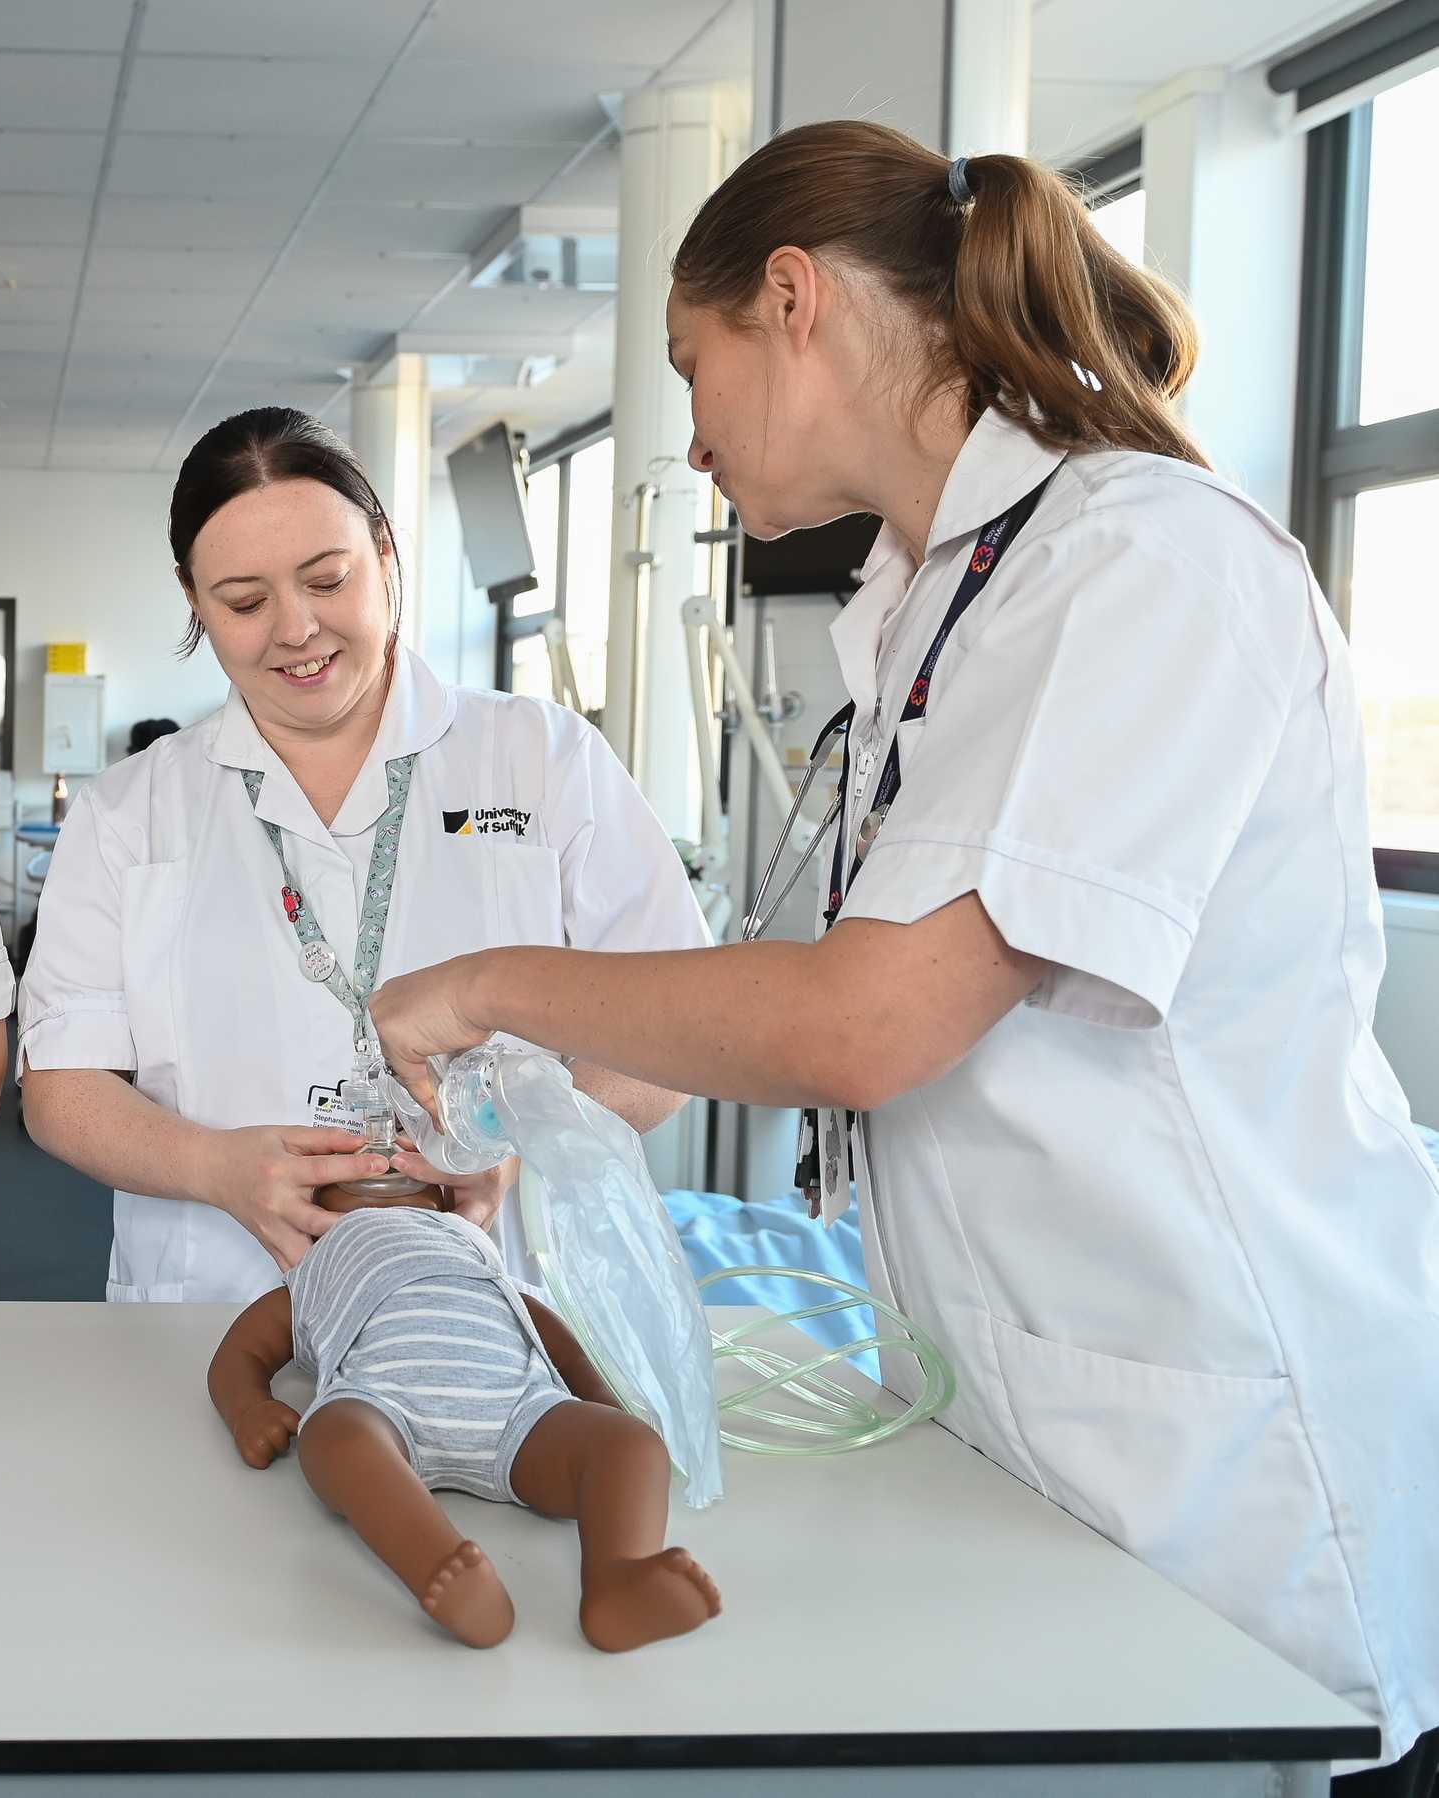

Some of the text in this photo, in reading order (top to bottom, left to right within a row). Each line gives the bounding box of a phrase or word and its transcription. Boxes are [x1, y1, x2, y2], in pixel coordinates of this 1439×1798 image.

[475, 807, 531, 824] Univerity
[492, 819, 526, 836] Sufflk
[313, 1113, 346, 1125] Stephanie
